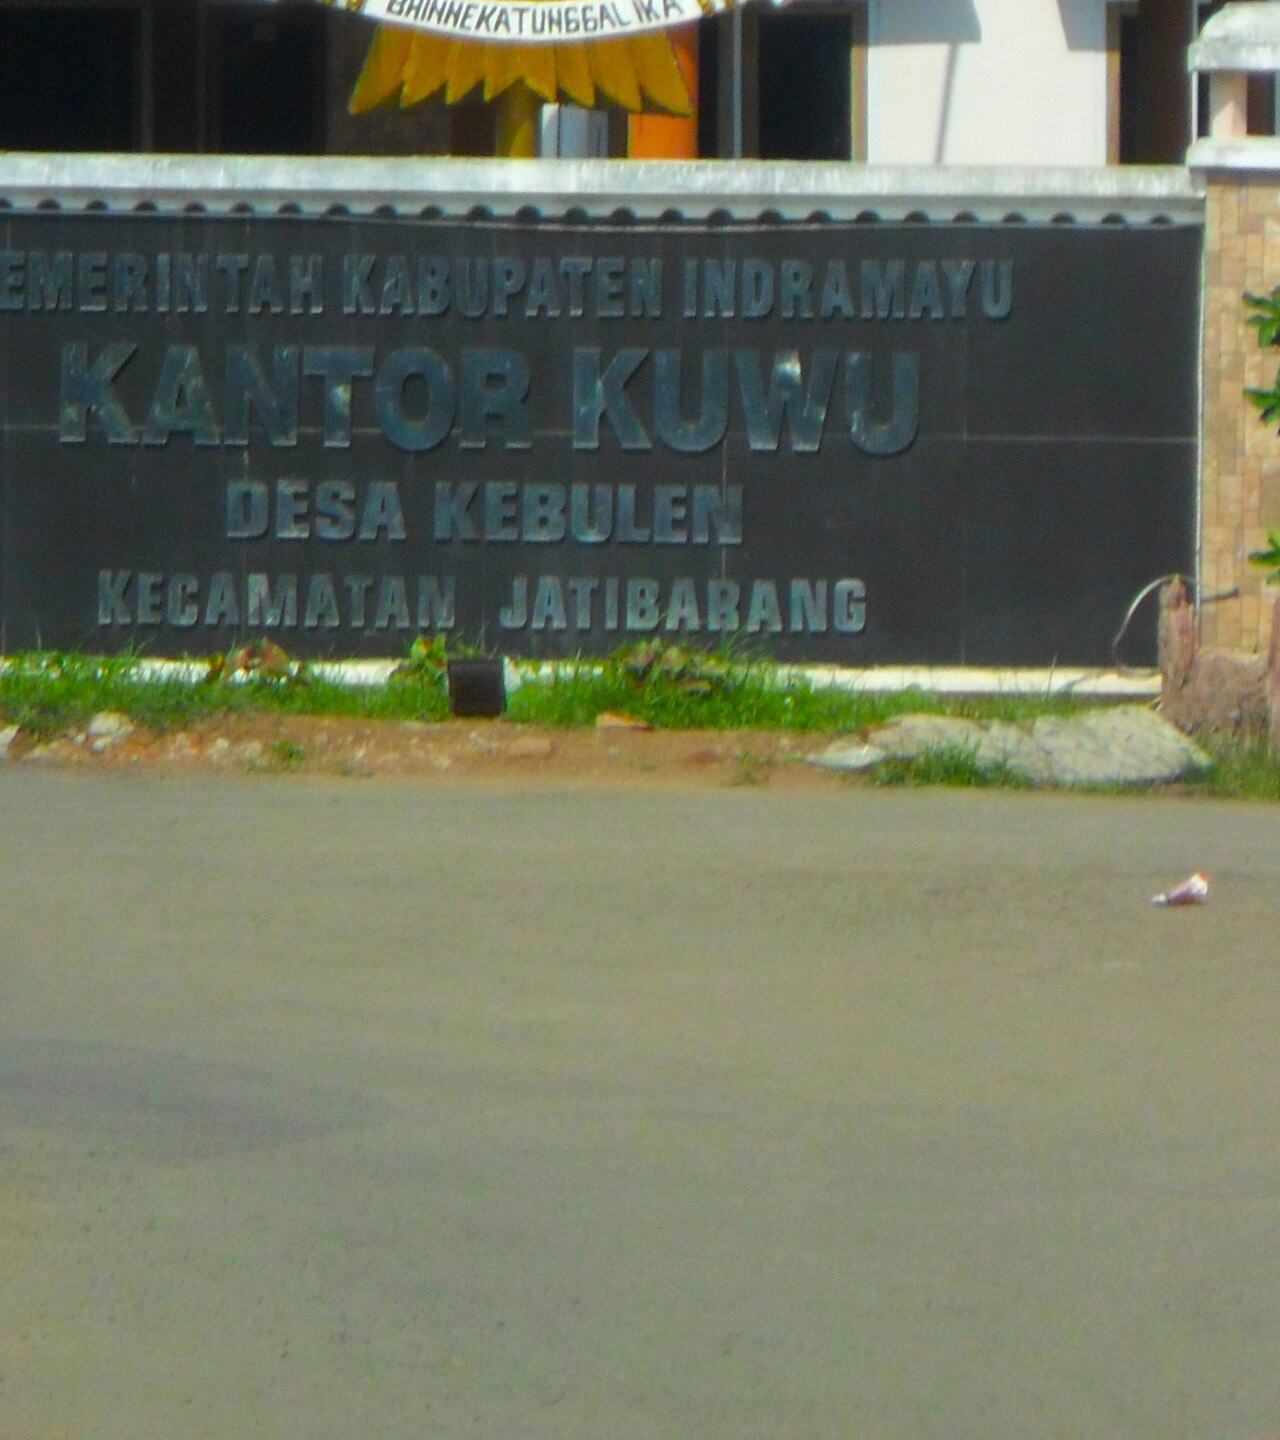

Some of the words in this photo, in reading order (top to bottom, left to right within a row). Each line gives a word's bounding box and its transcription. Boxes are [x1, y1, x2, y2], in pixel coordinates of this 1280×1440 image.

[343, 254, 662, 317] KABUPATEN
[684, 259, 1013, 318] INDRAMAYU
[59, 342, 532, 451] KANTOR
[572, 347, 920, 454] KUWU
[226, 479, 407, 540] DESA
[433, 480, 743, 544] KEBULEN
[98, 569, 456, 628] KECAMATAN
[499, 576, 867, 632] JATIBARANG
